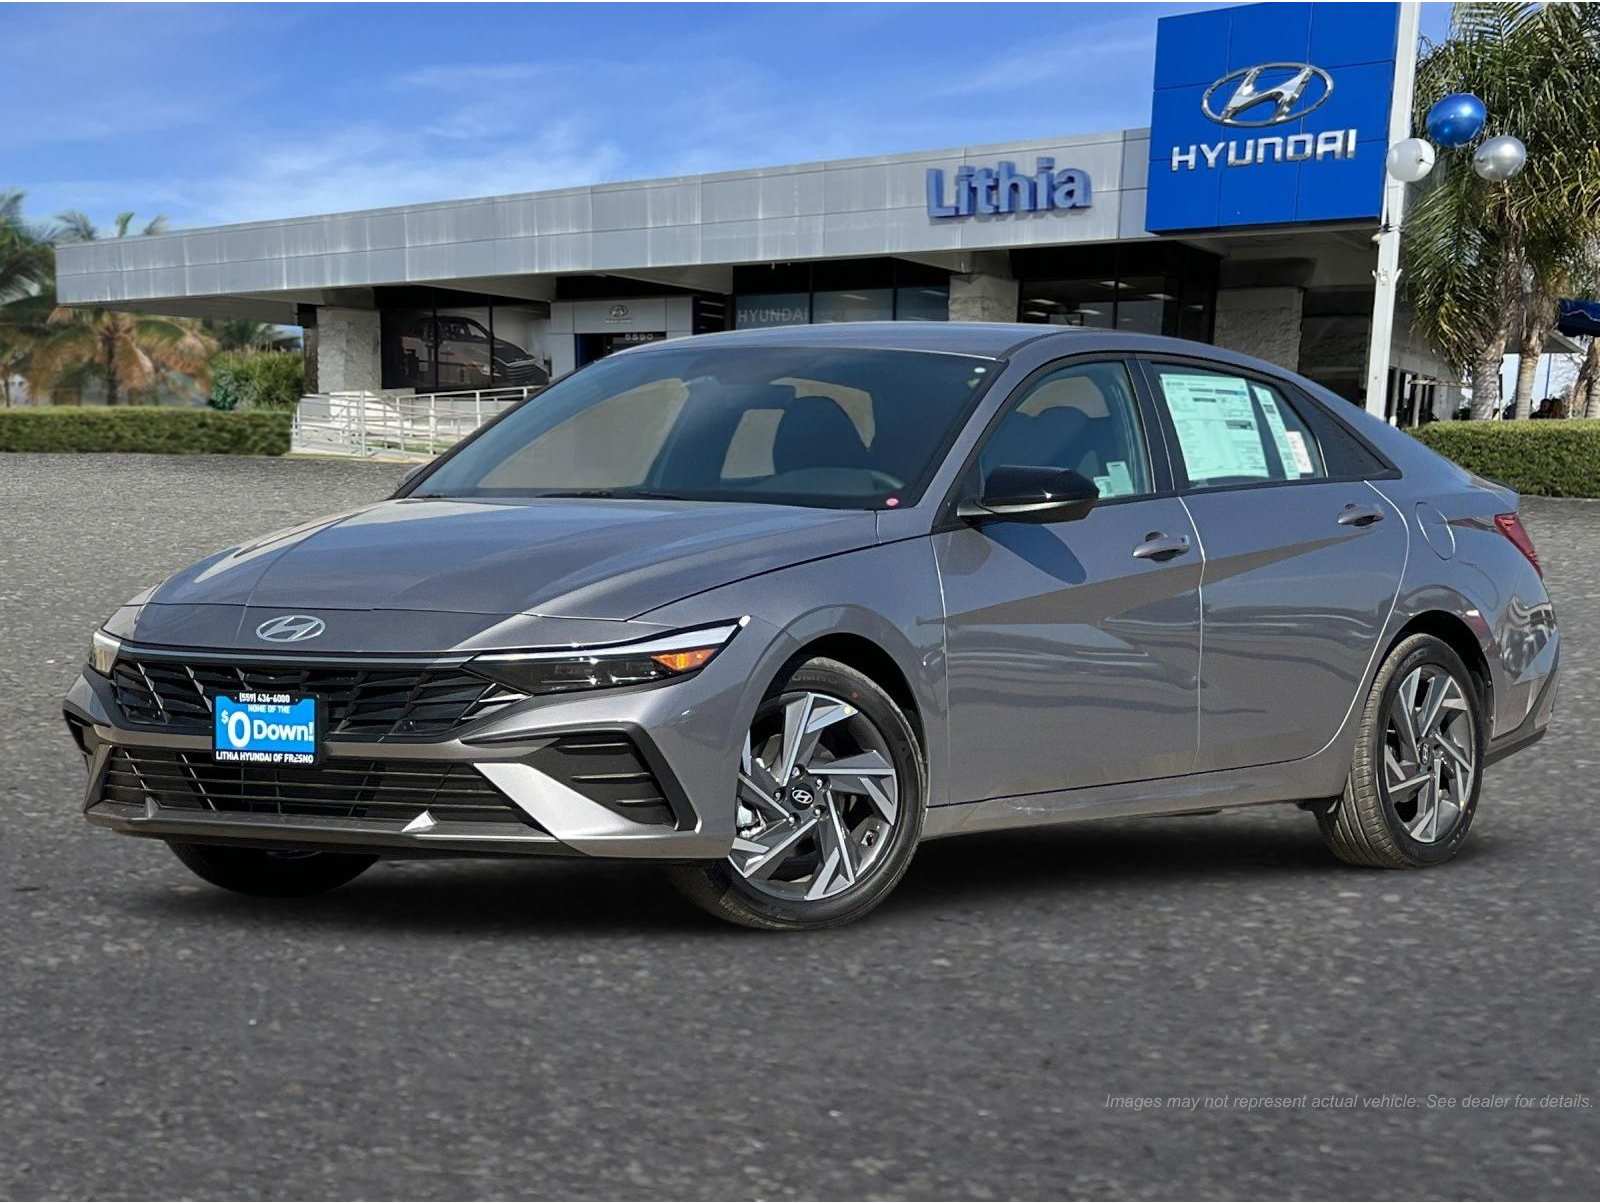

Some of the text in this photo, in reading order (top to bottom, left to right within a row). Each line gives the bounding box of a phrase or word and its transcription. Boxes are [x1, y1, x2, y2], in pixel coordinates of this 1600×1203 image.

[1171, 129, 1357, 171] HYUNDAI
[926, 156, 1093, 218] Lithia
[737, 307, 809, 323] HYUNDAI
[267, 705, 276, 713] OF
[277, 705, 291, 714] THE
[253, 719, 315, 742] Down!
[215, 751, 314, 763] LITHIA HYUNDAI OF FRESNO
